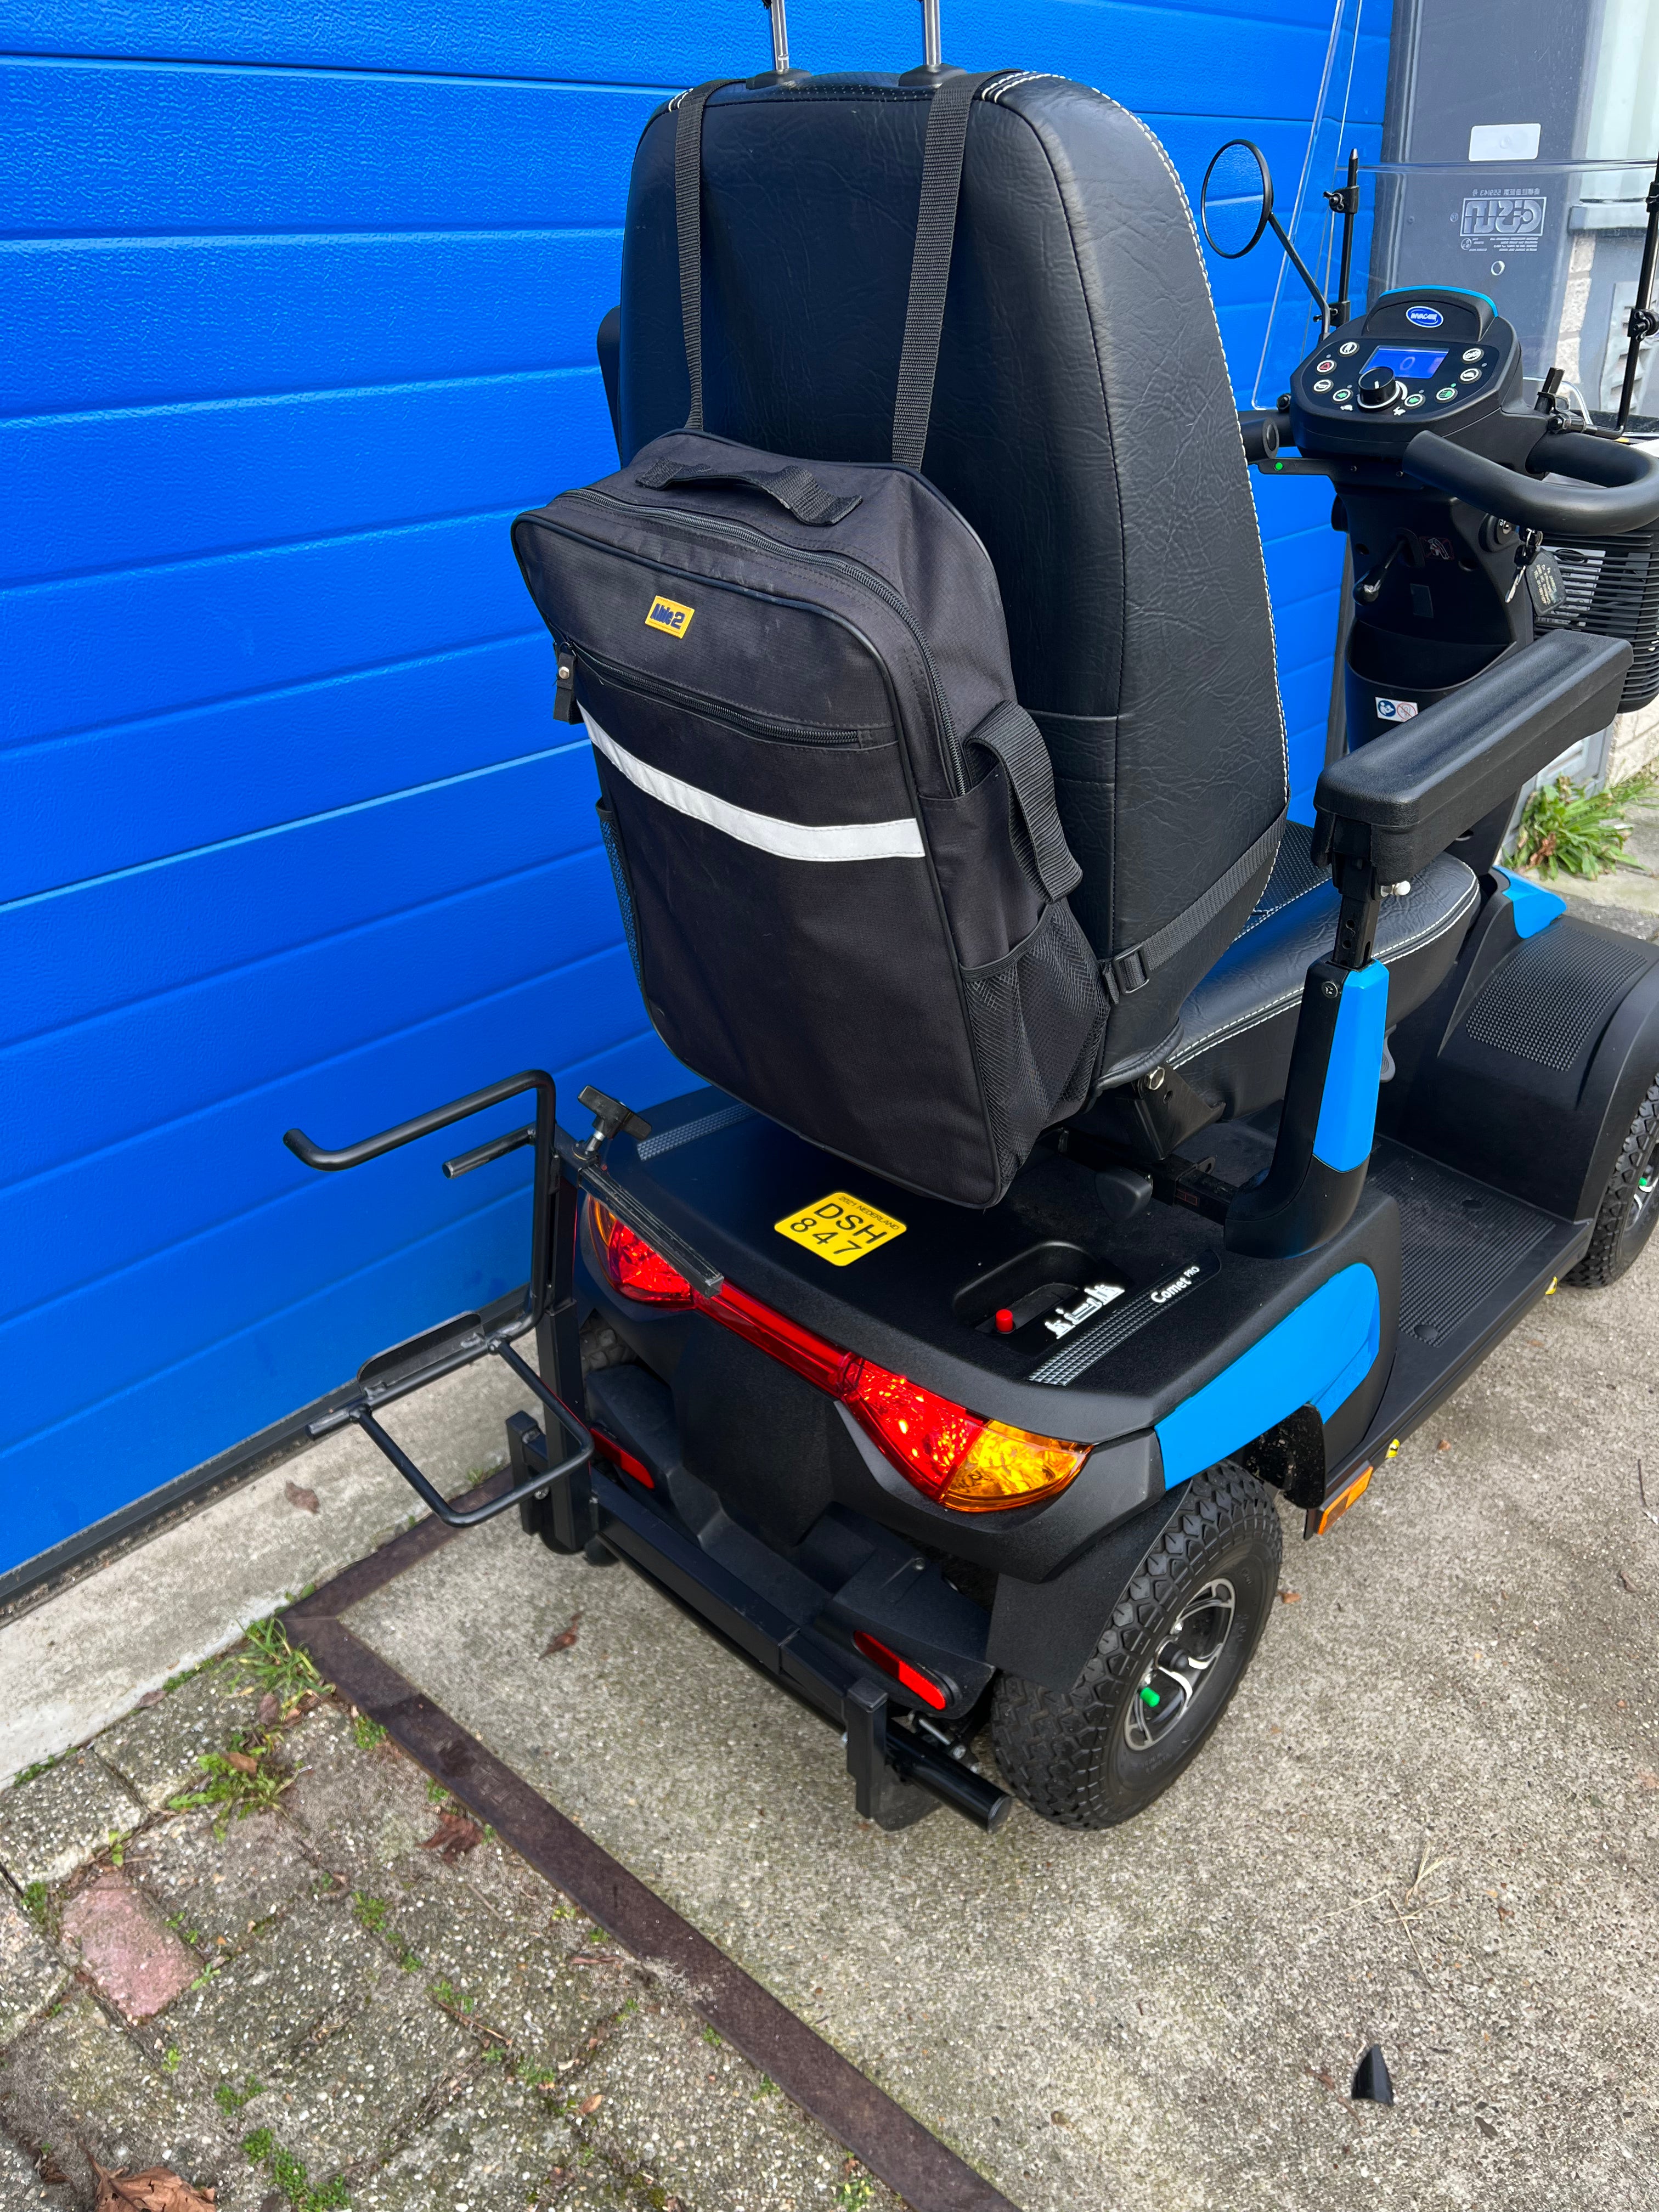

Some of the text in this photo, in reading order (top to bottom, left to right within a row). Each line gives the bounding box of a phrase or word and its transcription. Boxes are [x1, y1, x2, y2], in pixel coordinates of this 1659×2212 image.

[650, 603, 686, 630] Able2
[814, 1203, 888, 1244] DSH
[856, 1205, 900, 1231] NEDERLAND
[1151, 1266, 1200, 1303] Comet PRO
